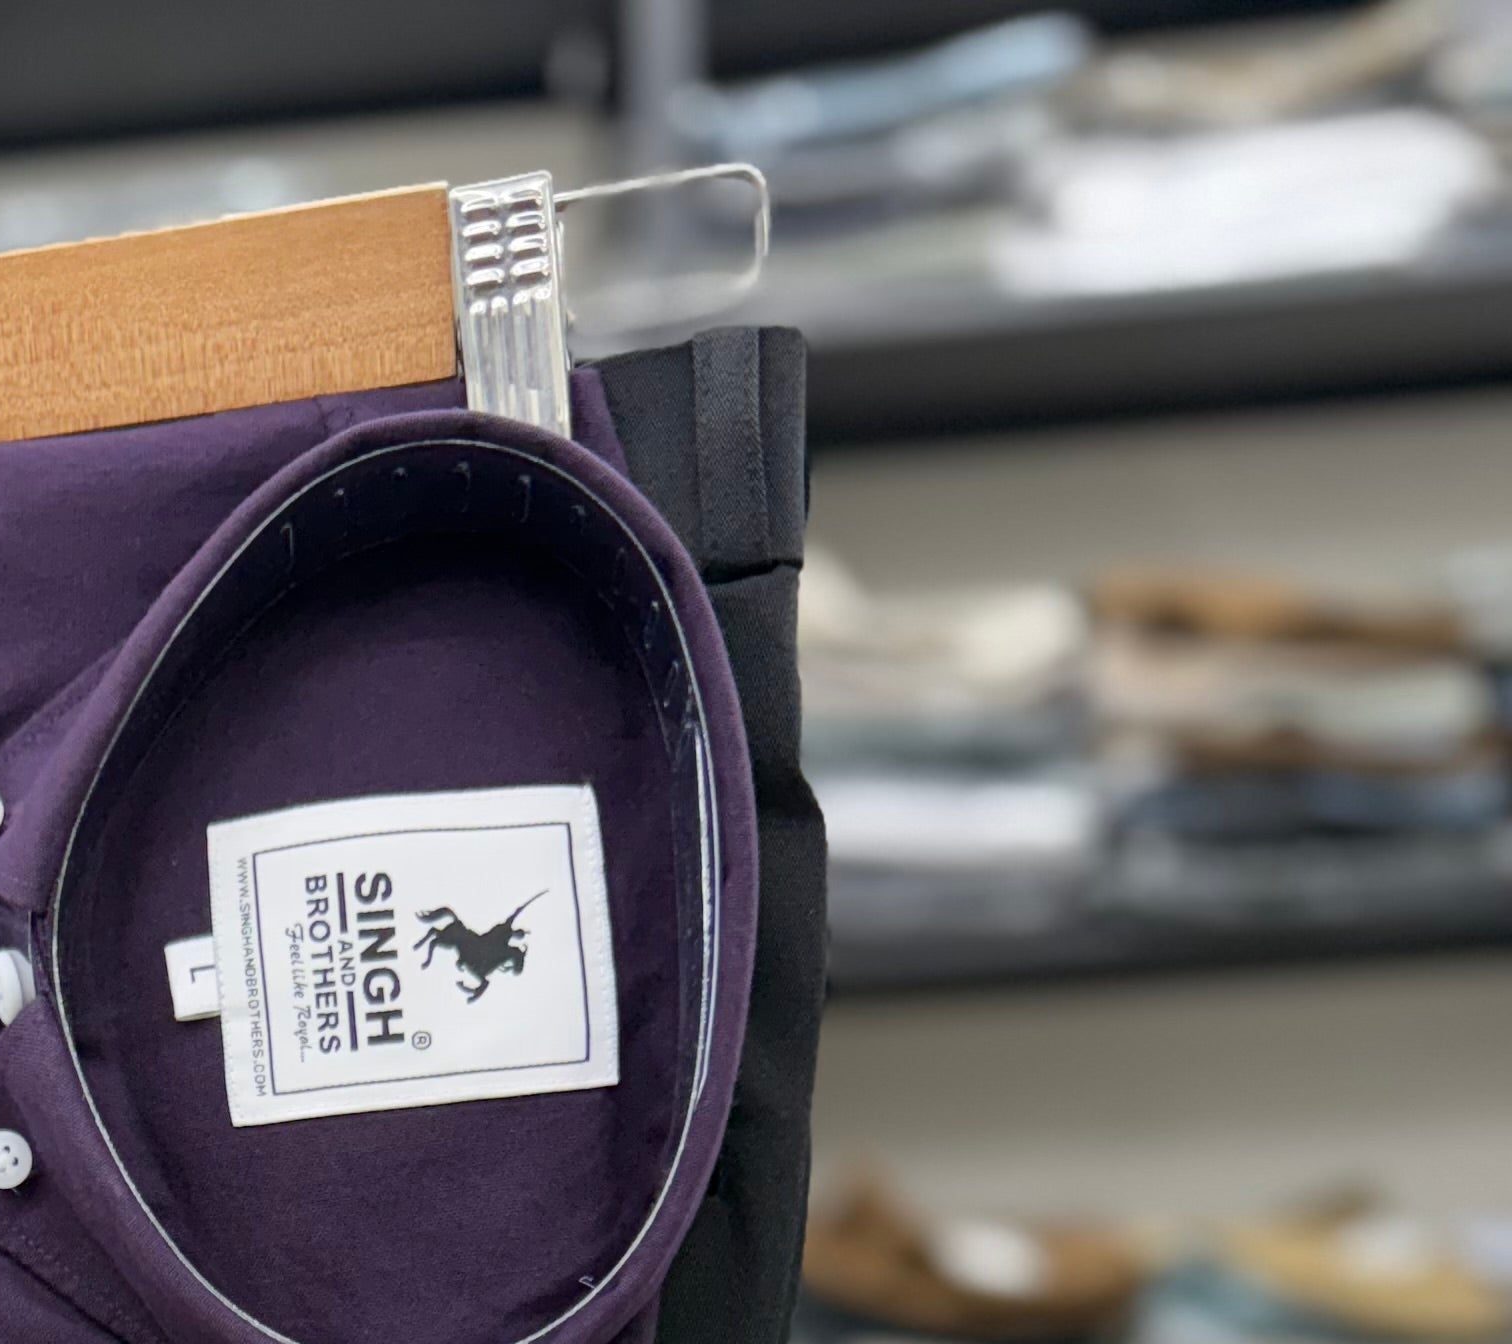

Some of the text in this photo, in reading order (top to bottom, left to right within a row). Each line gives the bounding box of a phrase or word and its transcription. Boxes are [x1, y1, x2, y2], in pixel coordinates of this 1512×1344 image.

[237, 857, 267, 1097] WWW.SINGHANDBROTHERS.COM
[285, 923, 305, 966] Feel
[291, 968, 308, 998] like
[305, 875, 340, 1054] BROTHERS
[339, 941, 355, 986] AND
[355, 872, 405, 1047] SINGH
